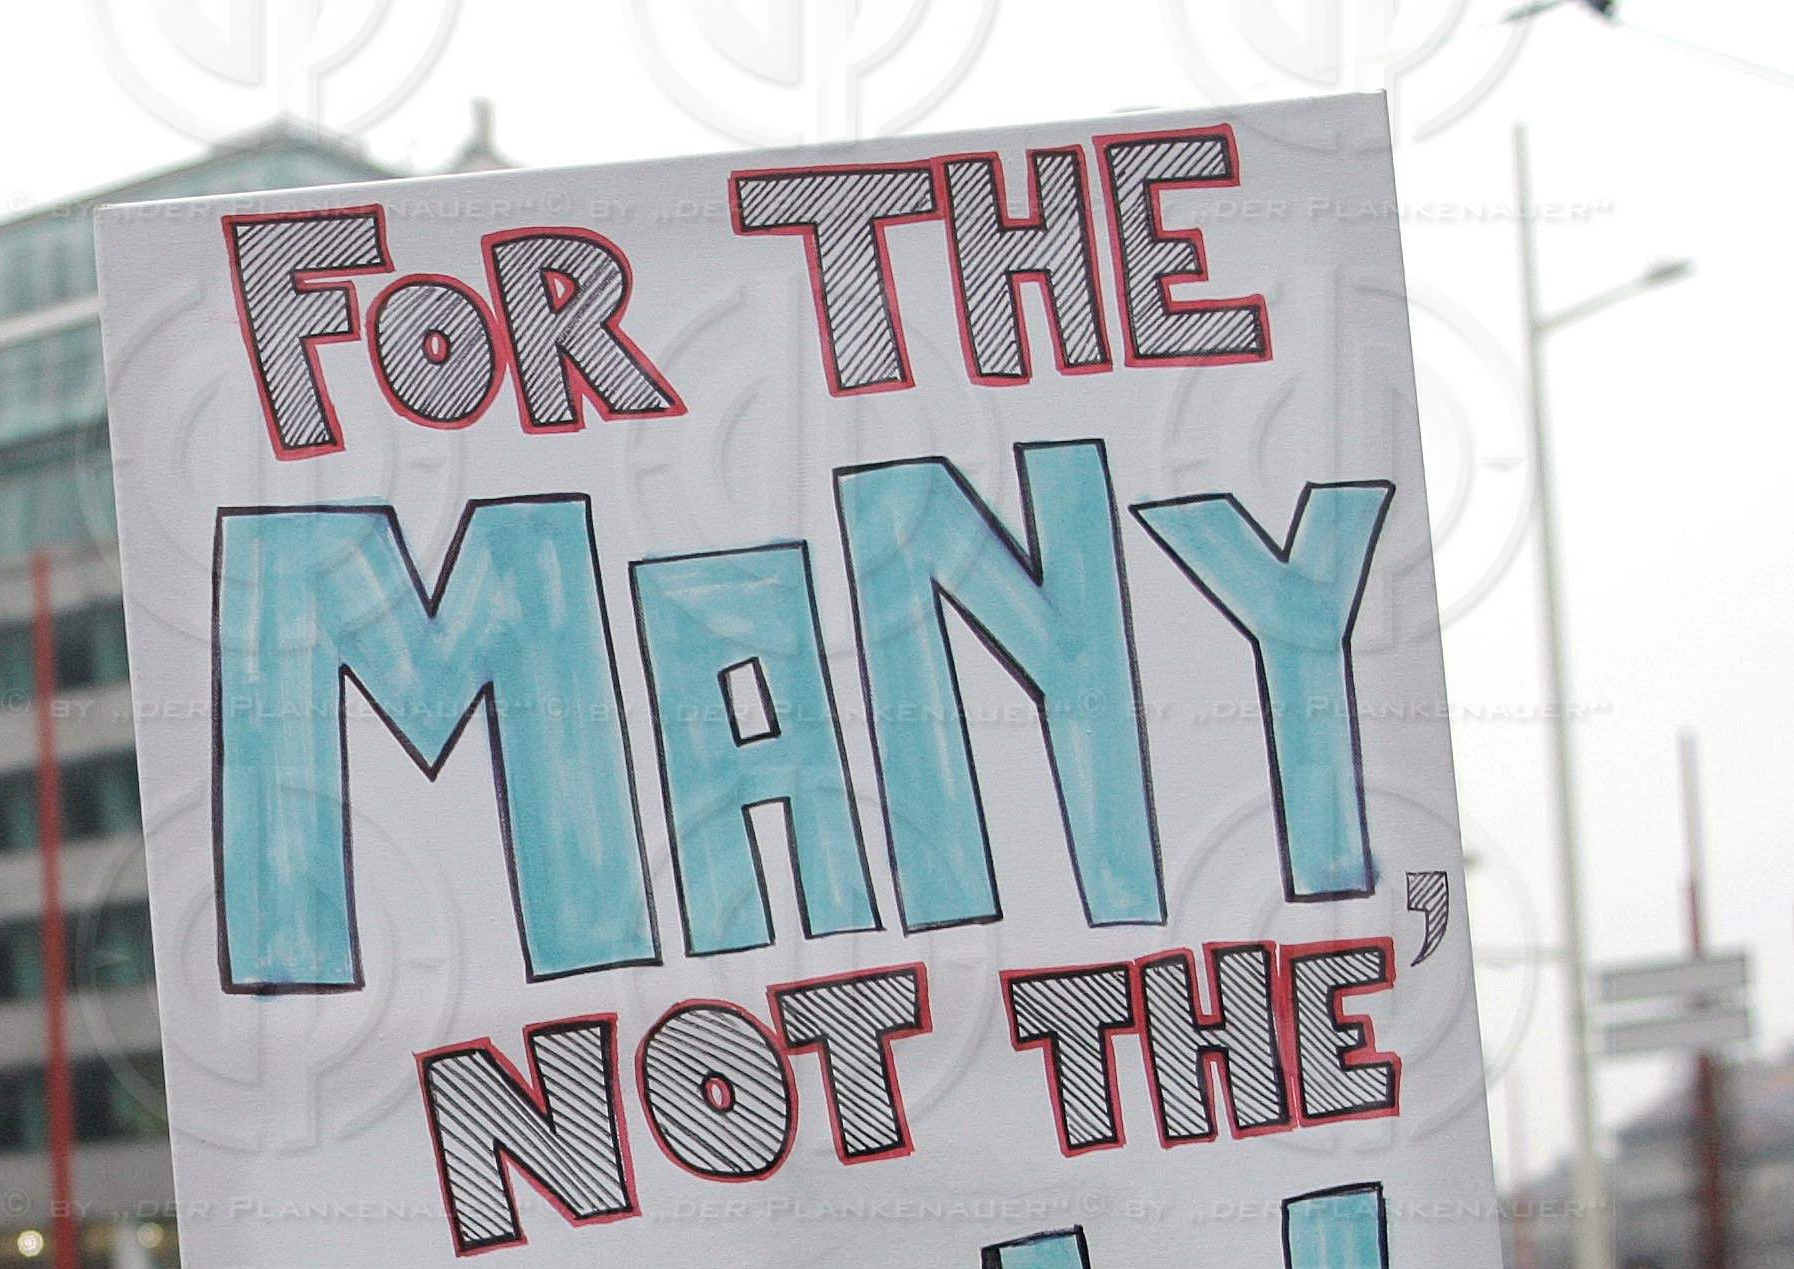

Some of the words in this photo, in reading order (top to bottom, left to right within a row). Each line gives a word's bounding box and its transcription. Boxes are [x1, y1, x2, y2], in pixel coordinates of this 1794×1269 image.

[728, 125, 1272, 396] THE
[413, 961, 932, 1256] NOT
[1000, 936, 1403, 1157] THE
